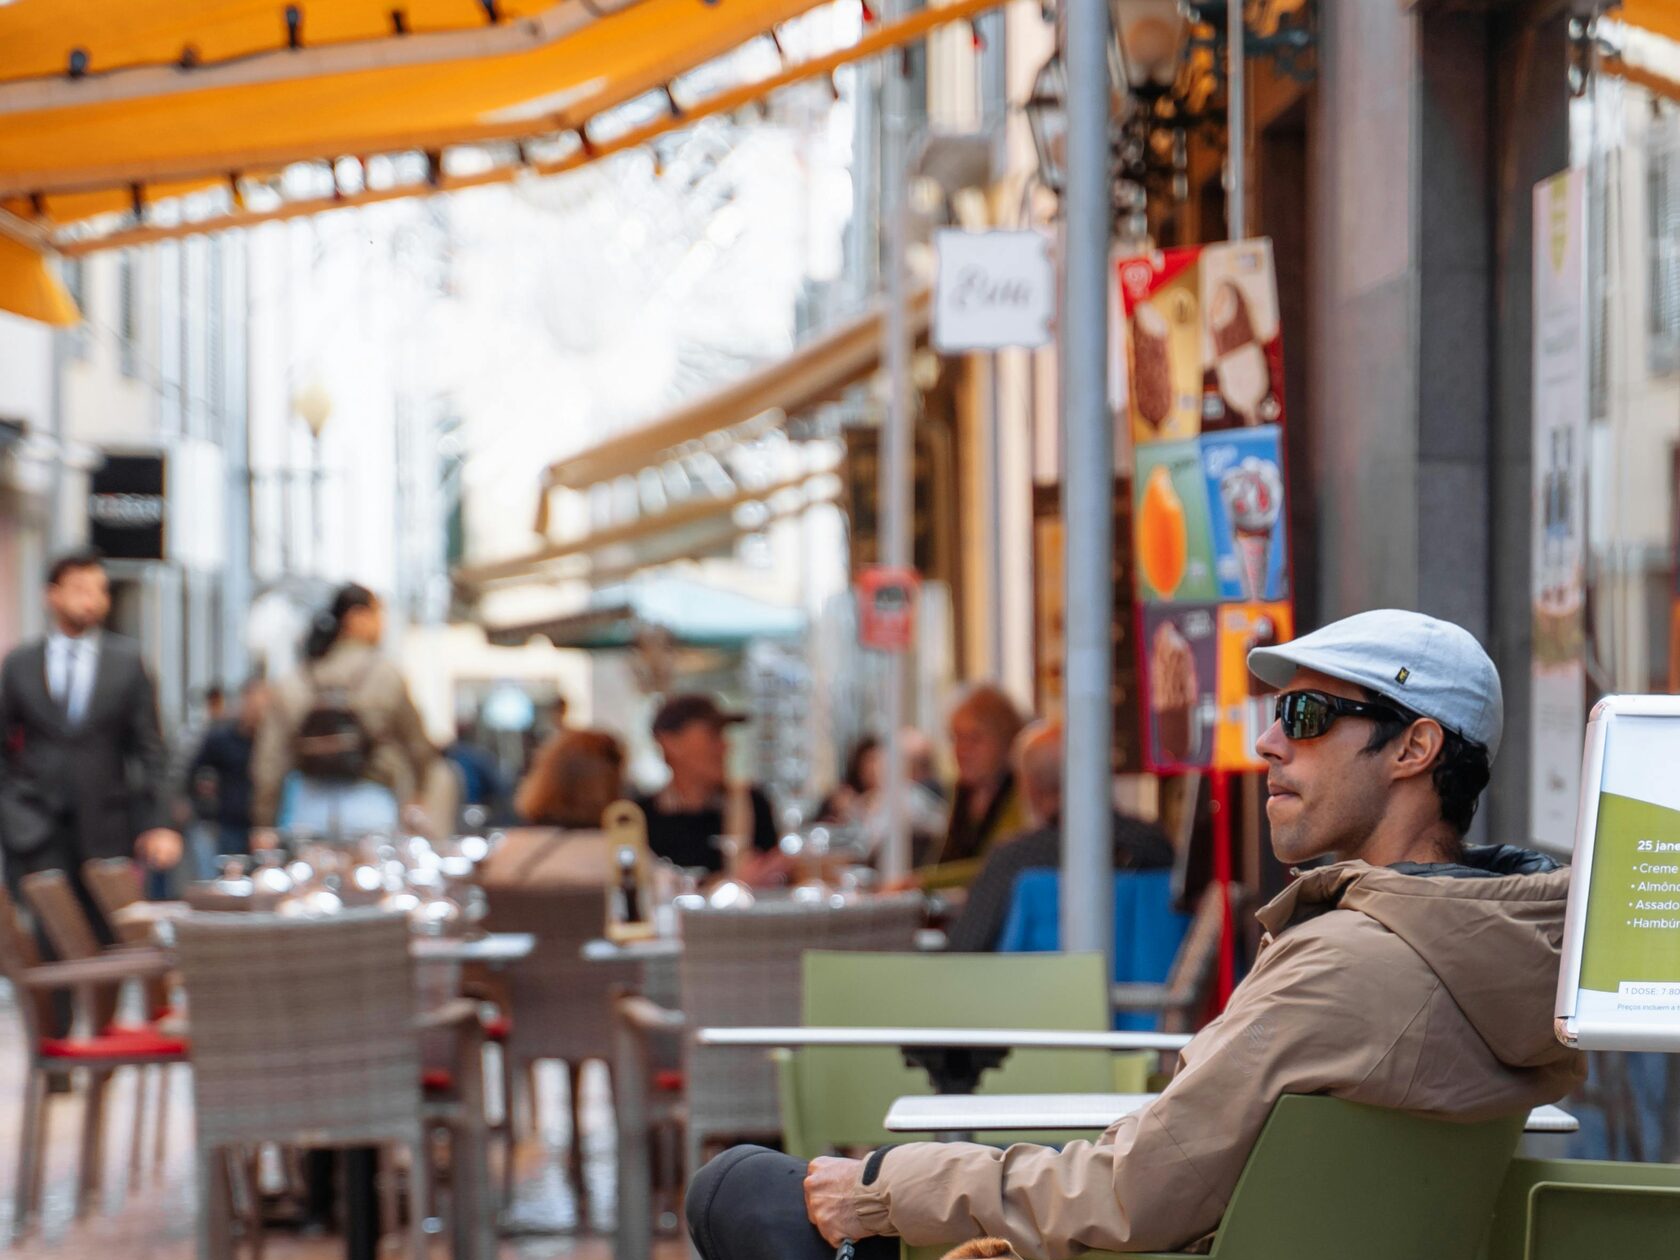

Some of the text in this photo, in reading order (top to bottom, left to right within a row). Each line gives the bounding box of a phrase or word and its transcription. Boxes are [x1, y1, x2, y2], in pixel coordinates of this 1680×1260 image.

[1637, 840, 1680, 852] 25 jane
[1639, 862, 1679, 874] Creme
[1635, 899, 1680, 910] Assado
